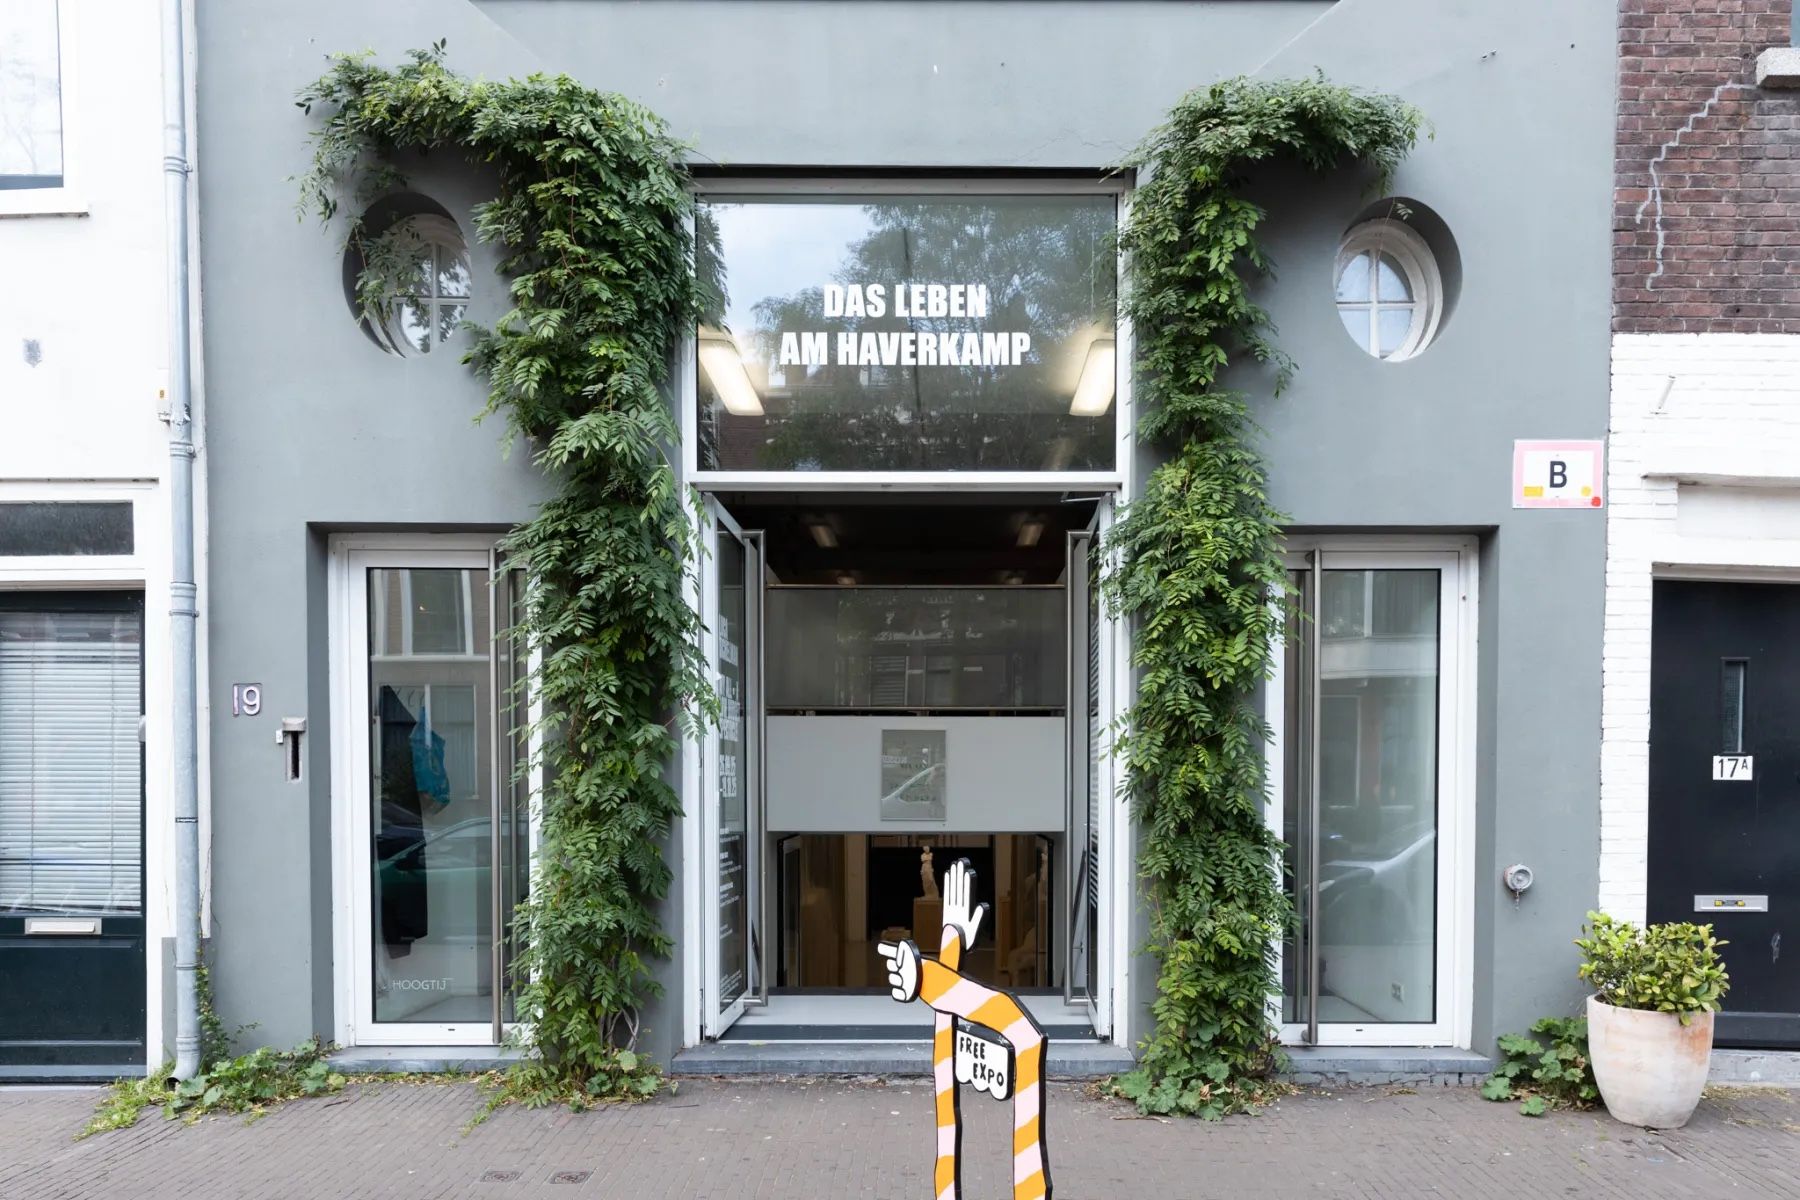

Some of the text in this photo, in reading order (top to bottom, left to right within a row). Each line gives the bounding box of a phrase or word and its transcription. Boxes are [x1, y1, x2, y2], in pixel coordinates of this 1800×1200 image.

[823, 283, 986, 318] DAS LEBEN
[779, 332, 1031, 365] AM HAVERKAMP
[1549, 460, 1568, 488] B
[233, 685, 261, 716] 19
[392, 979, 447, 990] HOOGTIJ
[960, 1036, 985, 1060] FREE
[973, 1063, 1005, 1087] EXPO
